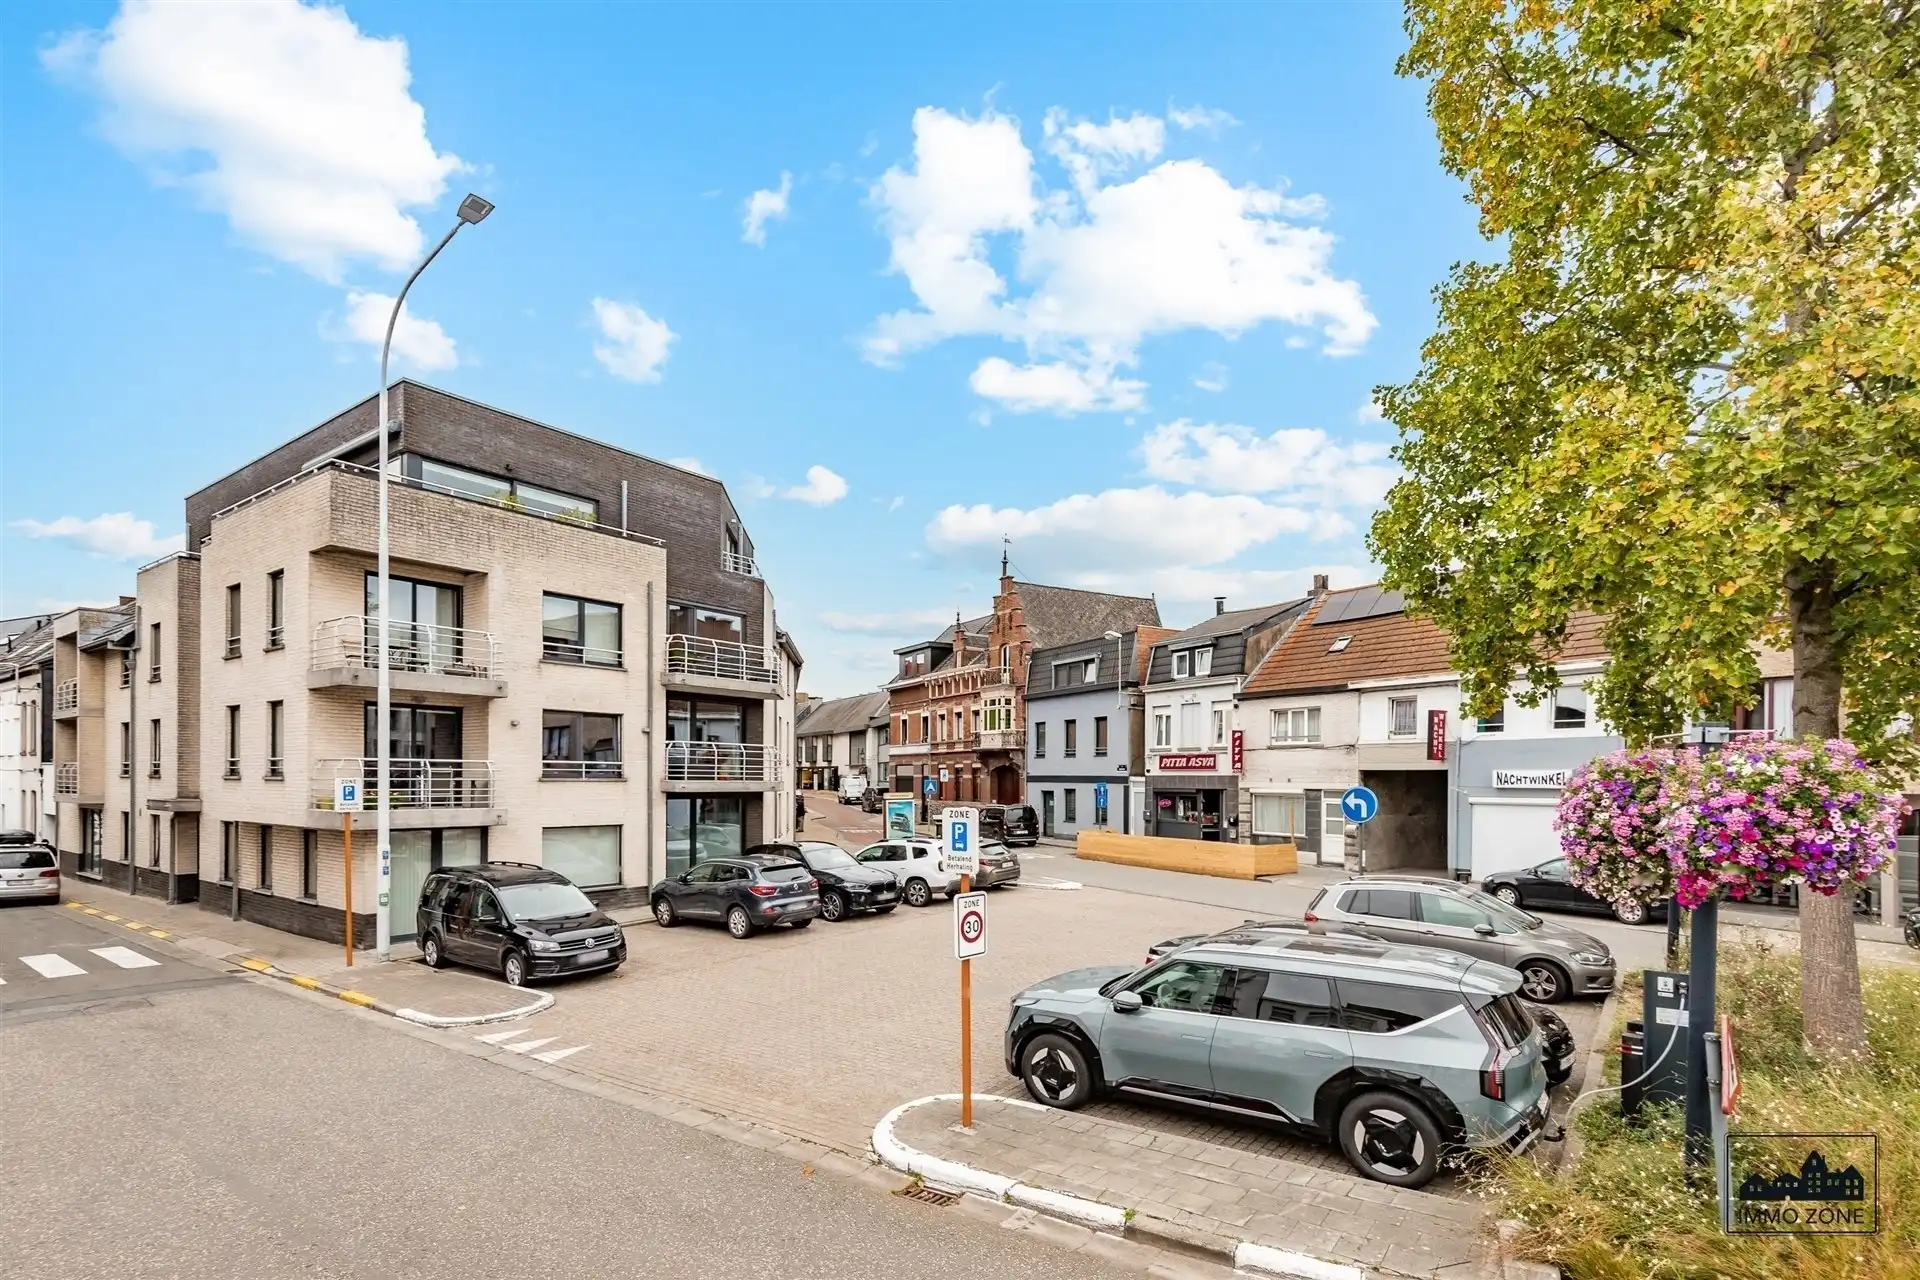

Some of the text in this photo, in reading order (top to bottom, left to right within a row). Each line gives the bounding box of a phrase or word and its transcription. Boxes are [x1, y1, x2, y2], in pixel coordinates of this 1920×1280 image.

[1234, 732, 1242, 768] PITTA
[1161, 757, 1187, 767] PITTA
[1496, 771, 1566, 786] NACHTWINKEL
[949, 810, 970, 819] ZONE
[954, 824, 964, 840] P
[947, 854, 972, 863] Betalend
[946, 863, 973, 872] Herhaling
[963, 899, 980, 909] ZONE
[965, 919, 979, 934] 30
